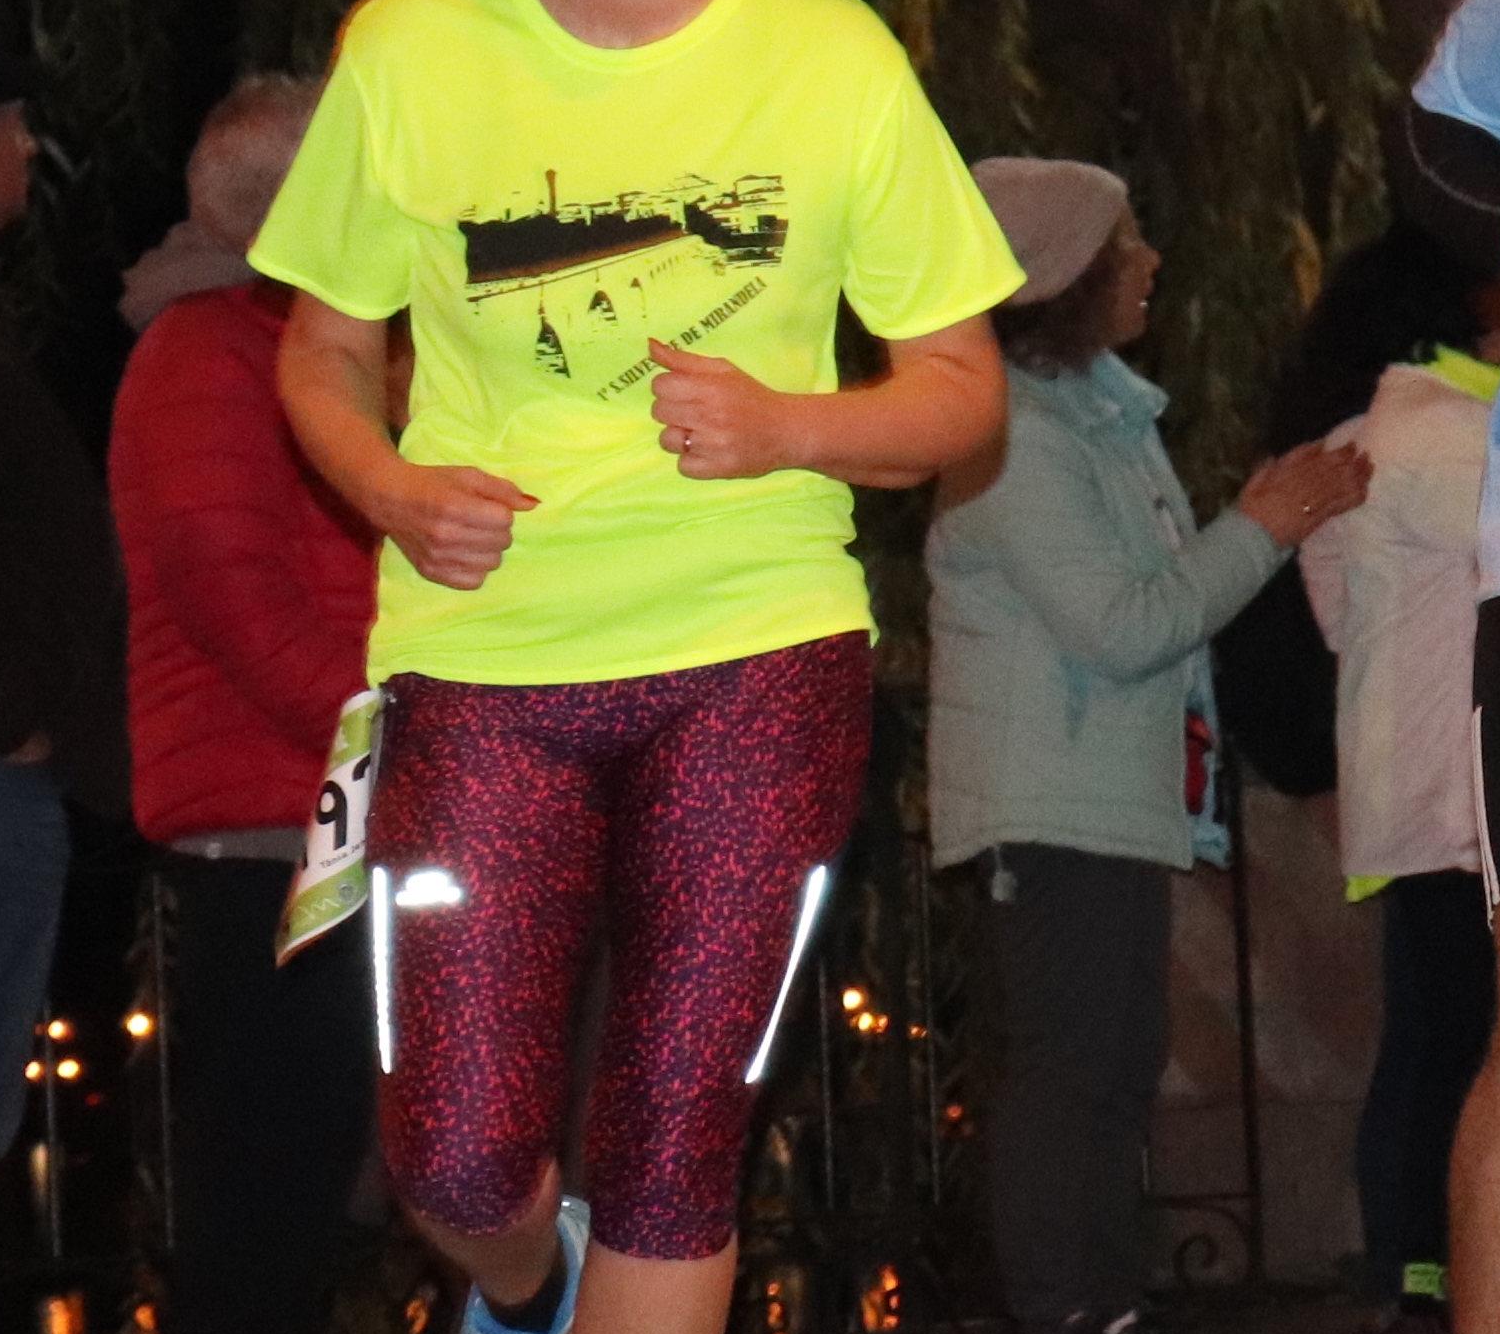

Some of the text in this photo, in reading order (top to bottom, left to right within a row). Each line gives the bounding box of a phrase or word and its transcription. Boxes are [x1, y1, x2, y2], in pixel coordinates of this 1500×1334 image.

[609, 339, 681, 394] S.SILVEE
[680, 325, 702, 346] DE
[700, 275, 767, 334] MIRANDELA
